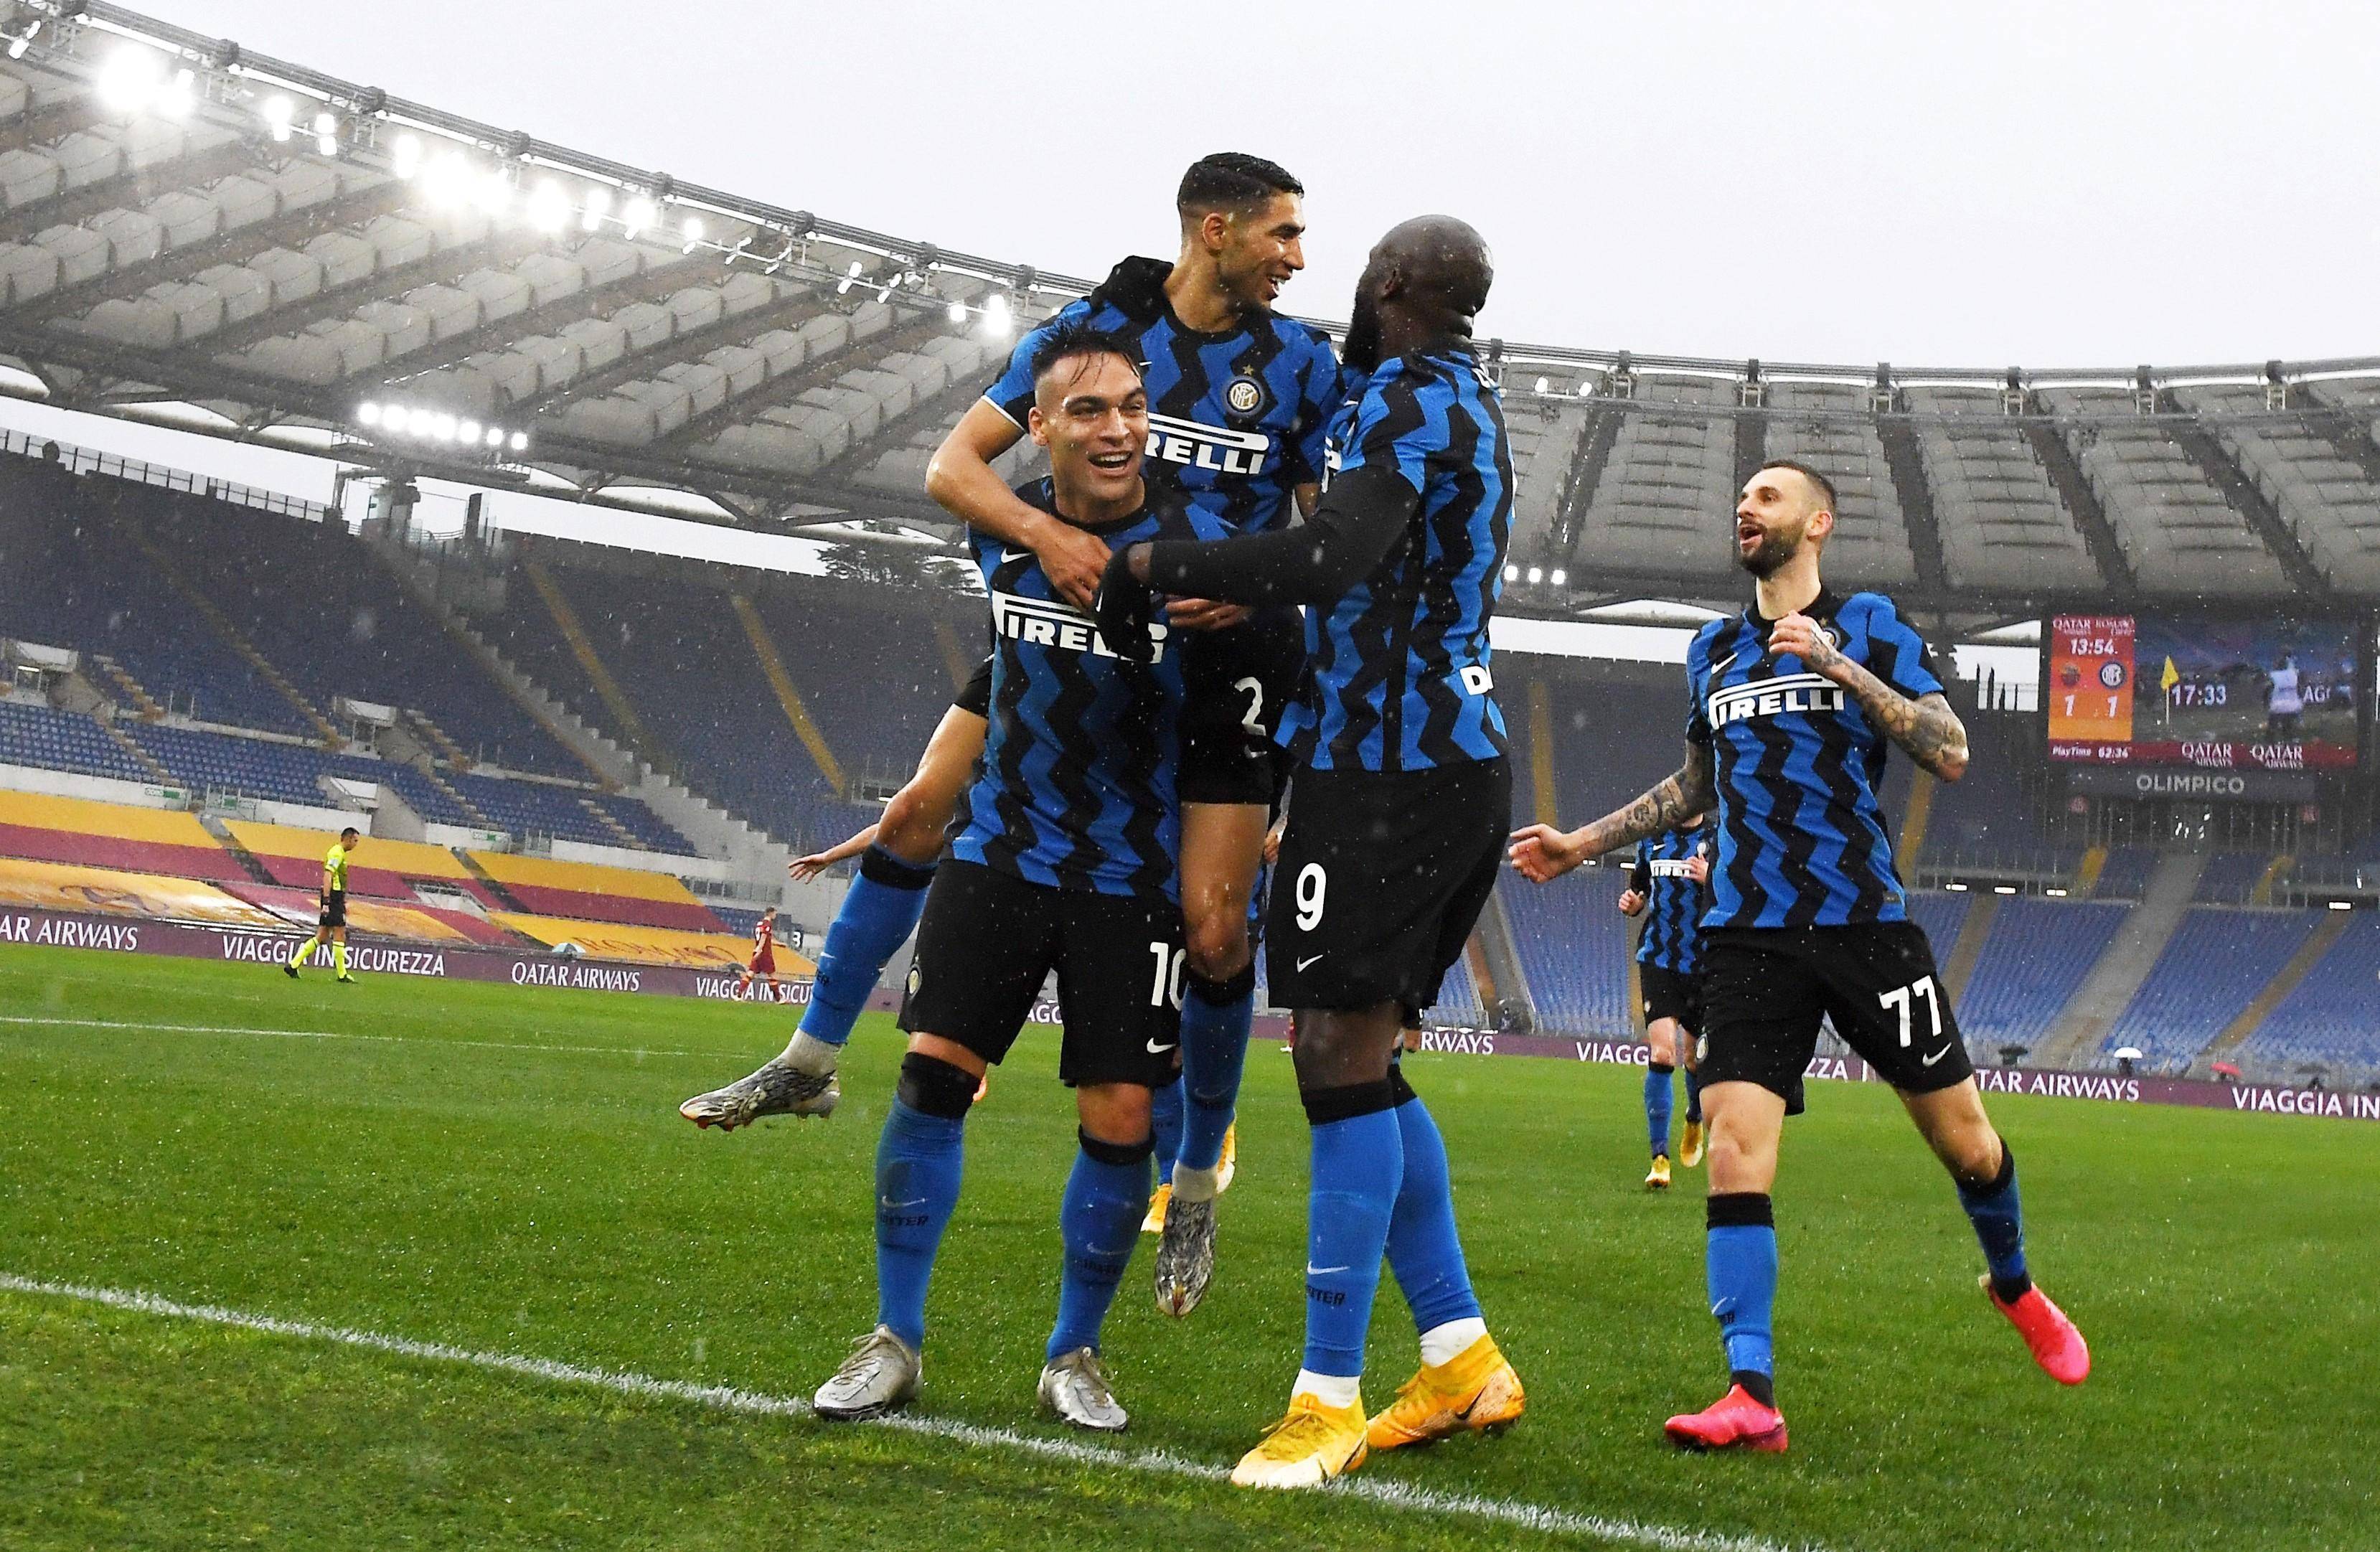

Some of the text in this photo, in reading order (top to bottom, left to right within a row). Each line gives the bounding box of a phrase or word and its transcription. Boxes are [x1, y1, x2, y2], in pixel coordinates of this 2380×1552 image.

[2070, 637, 2115, 656] 13:54
[1233, 676, 1267, 736] 2
[1708, 672, 1845, 730] PIRELLI
[2064, 694, 2118, 718] 1 1
[2171, 684, 2227, 707] 17:33
[2181, 740, 2303, 762] QATAR QATAR
[2136, 773, 2245, 794] OLIMPICO
[1295, 862, 1327, 932] 9
[36, 918, 138, 951] AIRWAYS
[222, 935, 308, 965] VIAGGI
[344, 946, 445, 977] SICUREZZA
[511, 961, 641, 992] QATAR AIRWAYS
[695, 977, 755, 1001] VIAGGA
[778, 983, 812, 1004] SICU
[1149, 941, 1187, 1012] 10
[1878, 974, 1942, 1048] 77
[2030, 1073, 2140, 1103] AIRWAYS
[2231, 1086, 2380, 1120] VIAGGIA IN
